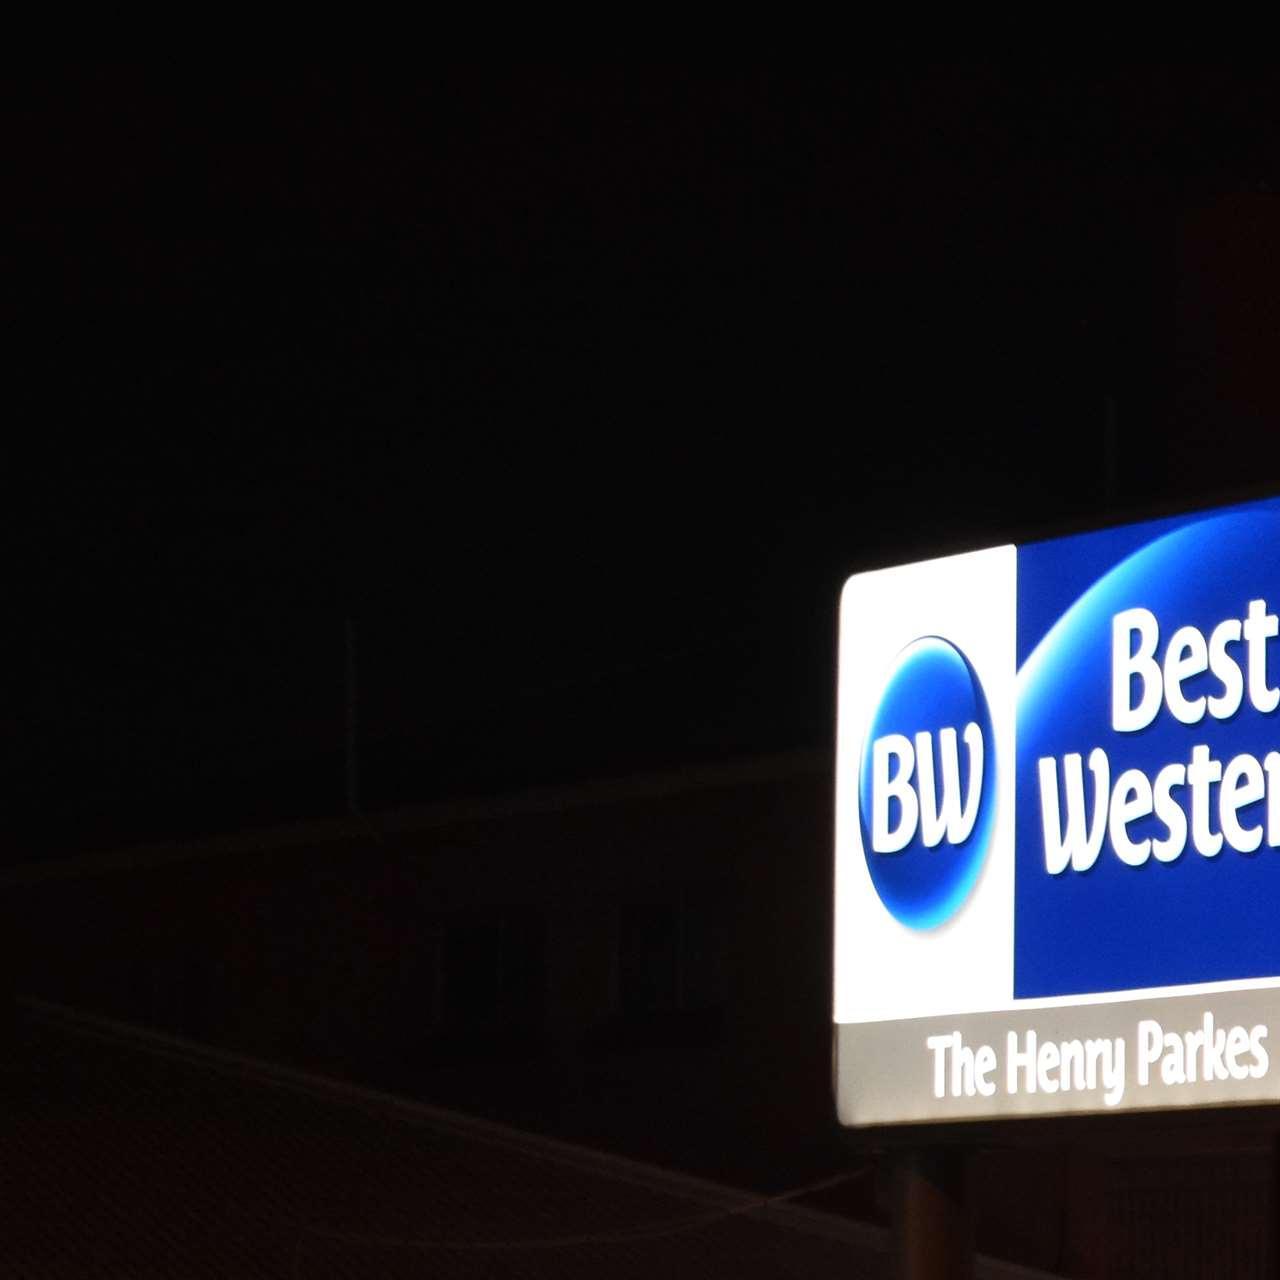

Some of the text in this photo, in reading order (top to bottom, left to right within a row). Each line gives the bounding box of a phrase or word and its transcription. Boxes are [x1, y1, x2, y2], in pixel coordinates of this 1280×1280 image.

[1111, 599, 1280, 732] Best
[872, 721, 985, 854] BW
[926, 1011, 1270, 1106] The Henry Parkes
